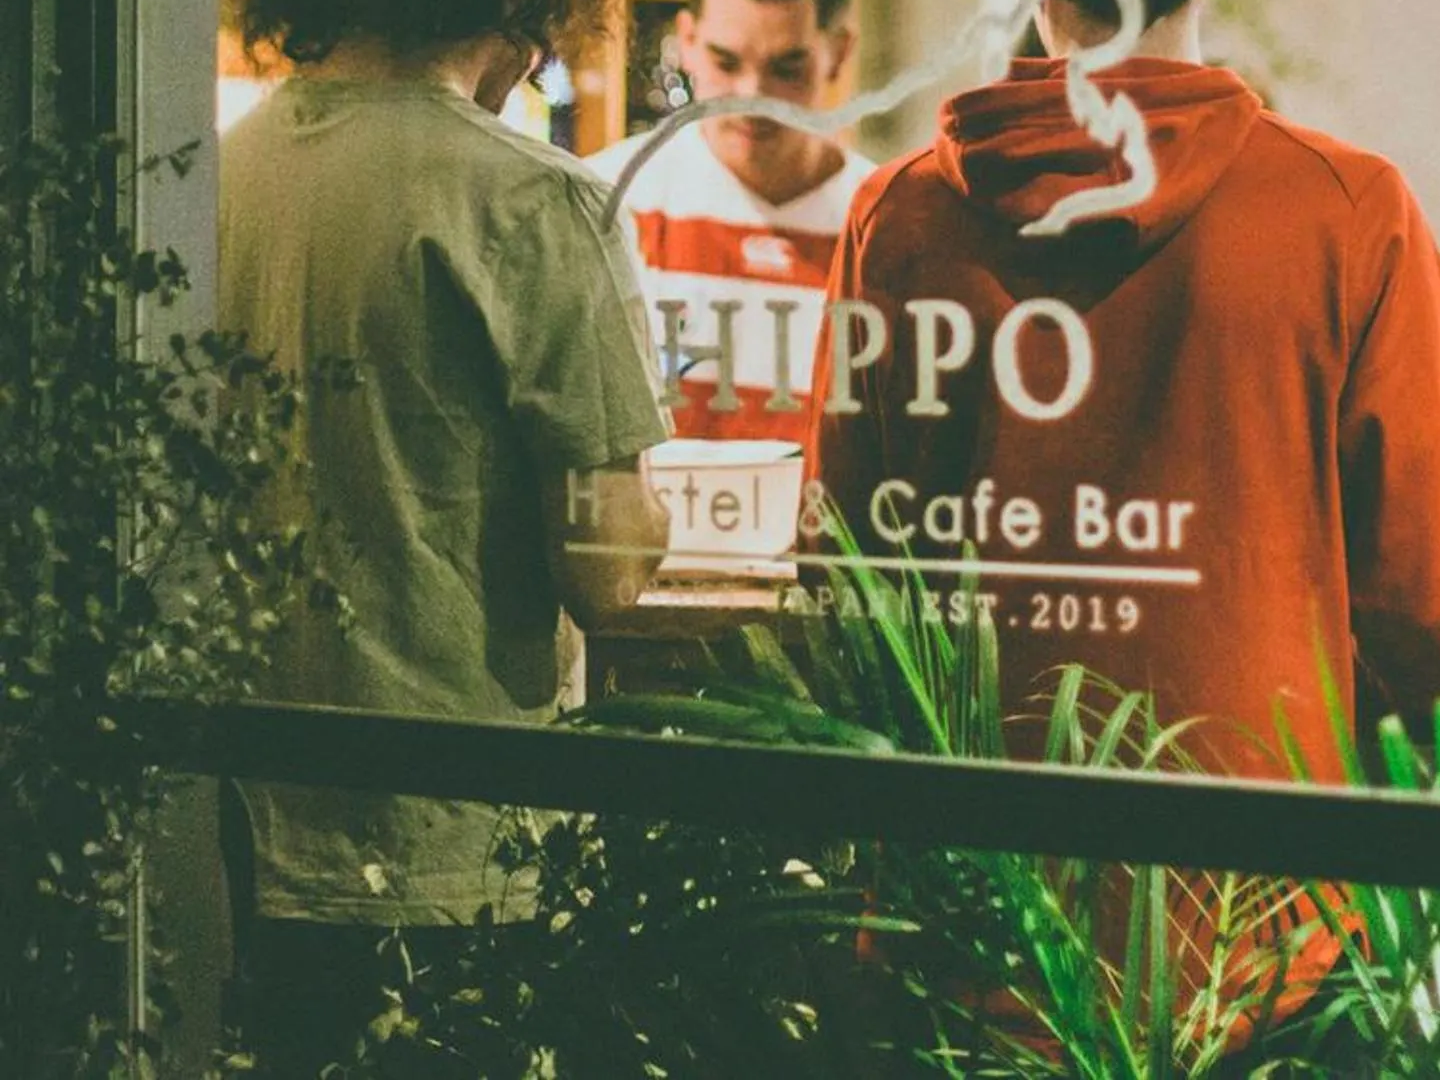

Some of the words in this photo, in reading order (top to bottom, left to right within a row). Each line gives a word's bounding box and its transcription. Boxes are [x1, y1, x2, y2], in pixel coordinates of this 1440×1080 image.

[656, 297, 1094, 420] HIPPO
[799, 479, 838, 536] &
[869, 478, 1042, 548] Cafe
[1075, 483, 1195, 550] Bar
